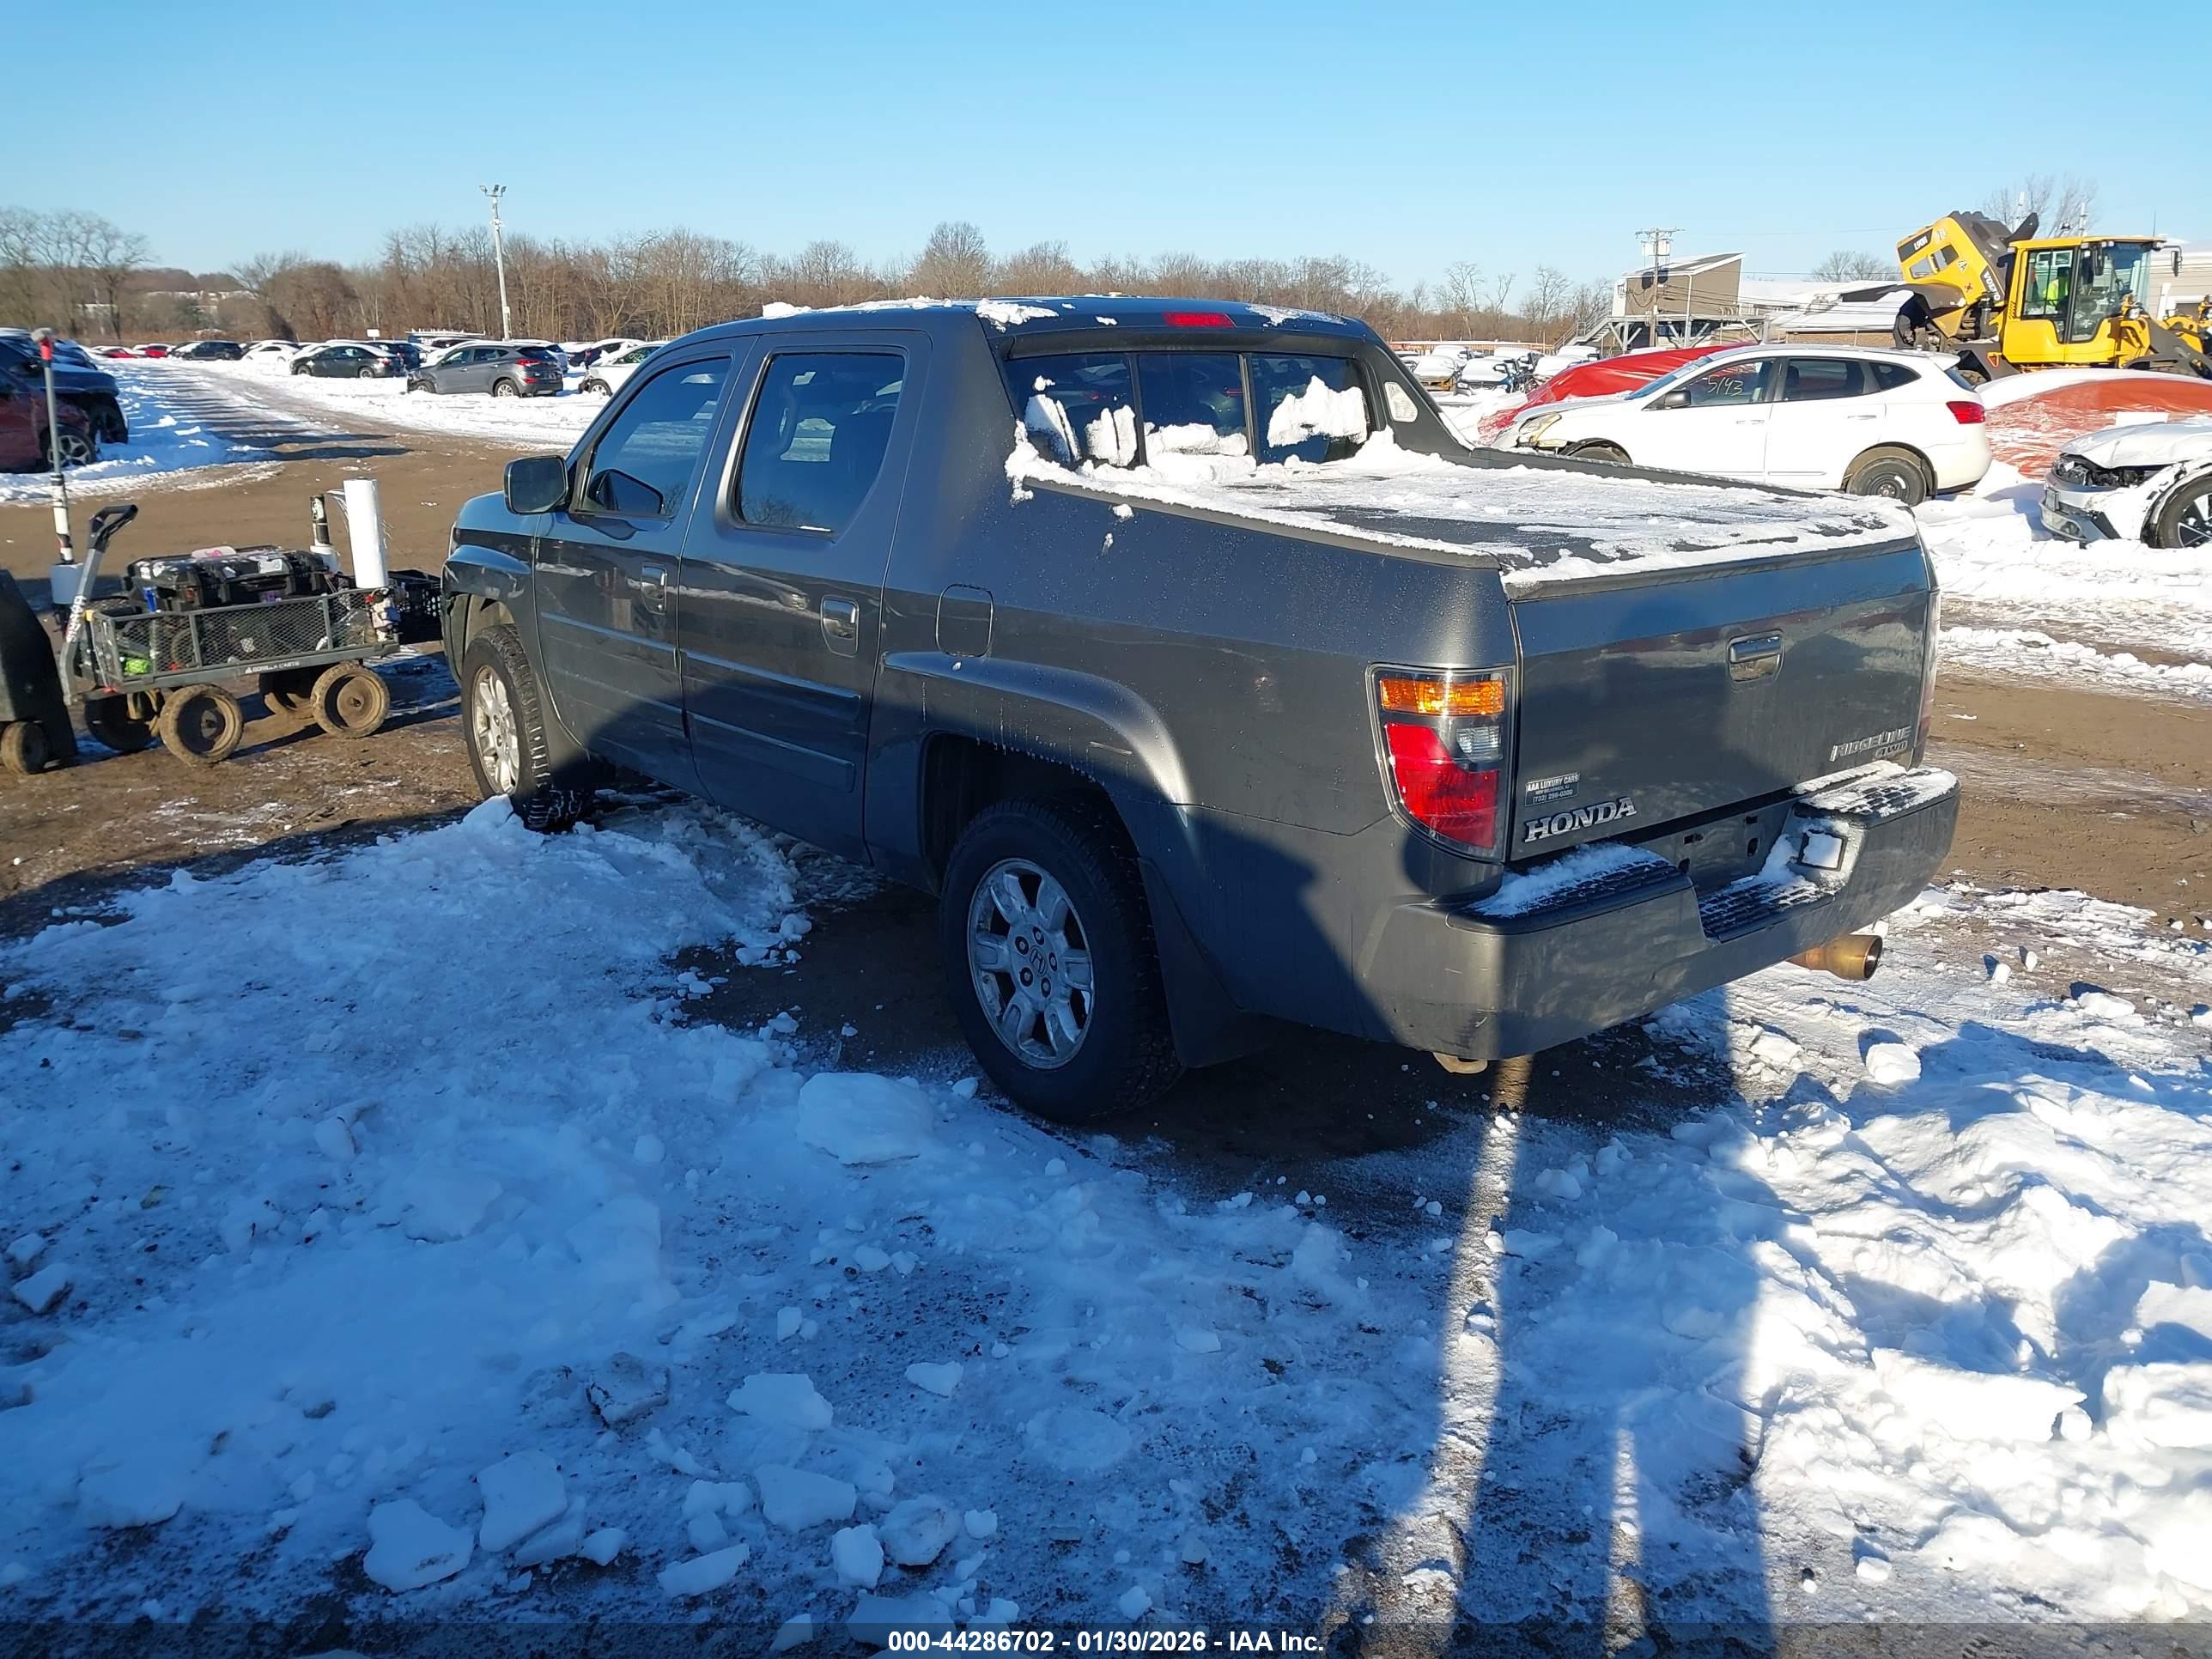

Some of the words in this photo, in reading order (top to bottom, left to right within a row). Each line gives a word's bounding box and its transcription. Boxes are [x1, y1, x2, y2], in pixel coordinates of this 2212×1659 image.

[1984, 270, 2001, 301] VOLVO
[1829, 725, 1912, 762] RIDGELINE
[1527, 781, 1540, 792] AAA
[1540, 776, 1564, 789] LUXURY
[1564, 774, 1579, 784] CARS
[1525, 797, 1637, 842] HONDA
